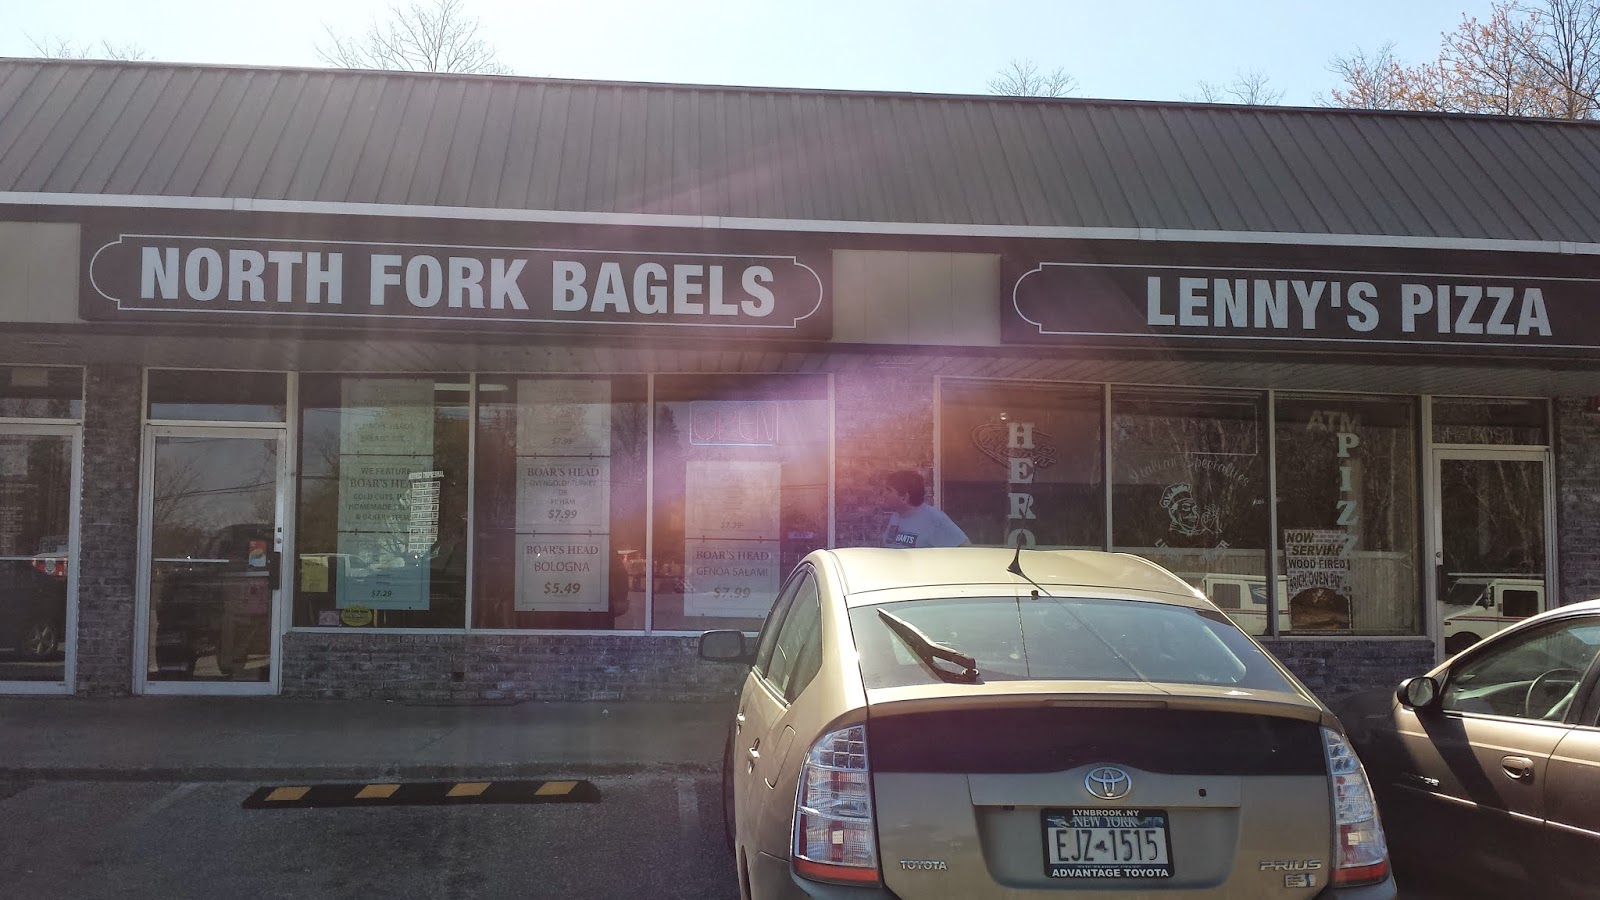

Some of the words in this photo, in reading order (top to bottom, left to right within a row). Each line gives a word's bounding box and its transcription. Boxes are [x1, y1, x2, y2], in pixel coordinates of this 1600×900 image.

[141, 246, 342, 304] NORTH
[370, 254, 529, 310] FORK
[552, 260, 775, 317] BAGELS
[1147, 276, 1379, 332] LENNY'S
[1401, 283, 1552, 336] PIZZA
[693, 405, 774, 440] OPEN
[1306, 410, 1360, 432] ATM
[361, 467, 376, 475] WE
[376, 467, 411, 475] FEATURE
[527, 467, 566, 477] BOAR'S
[569, 467, 600, 477] HEAD
[350, 479, 389, 488] BOAR'S
[348, 503, 392, 511] HOMEMADE
[548, 509, 578, 519] $7.99
[1286, 532, 1314, 544] NOW
[526, 545, 565, 555] BOAR'S
[567, 546, 599, 555] HEAD
[696, 550, 735, 560] BOAR'S
[738, 551, 769, 560] HEAD
[1291, 545, 1344, 556] SERVING
[534, 561, 590, 571] BOLOGNA
[1288, 559, 1316, 569] WOOD
[1319, 559, 1346, 569] FIRED
[696, 567, 730, 576] GENOA
[732, 568, 769, 577] SALAMI
[1289, 574, 1308, 592] BRICK
[1309, 571, 1329, 586] OVEN
[544, 581, 581, 594] $5.49
[714, 585, 751, 599] $7.99
[1070, 816, 1100, 828] NEW
[1103, 816, 1141, 828] YORK
[1056, 829, 1094, 862] EJZ
[1109, 829, 1157, 861] 1515
[900, 860, 948, 870] TOYOTA
[1260, 859, 1322, 871] PRIUS
[1052, 868, 1121, 877] ADVANTAGE
[1124, 868, 1169, 877] TOYOTA
